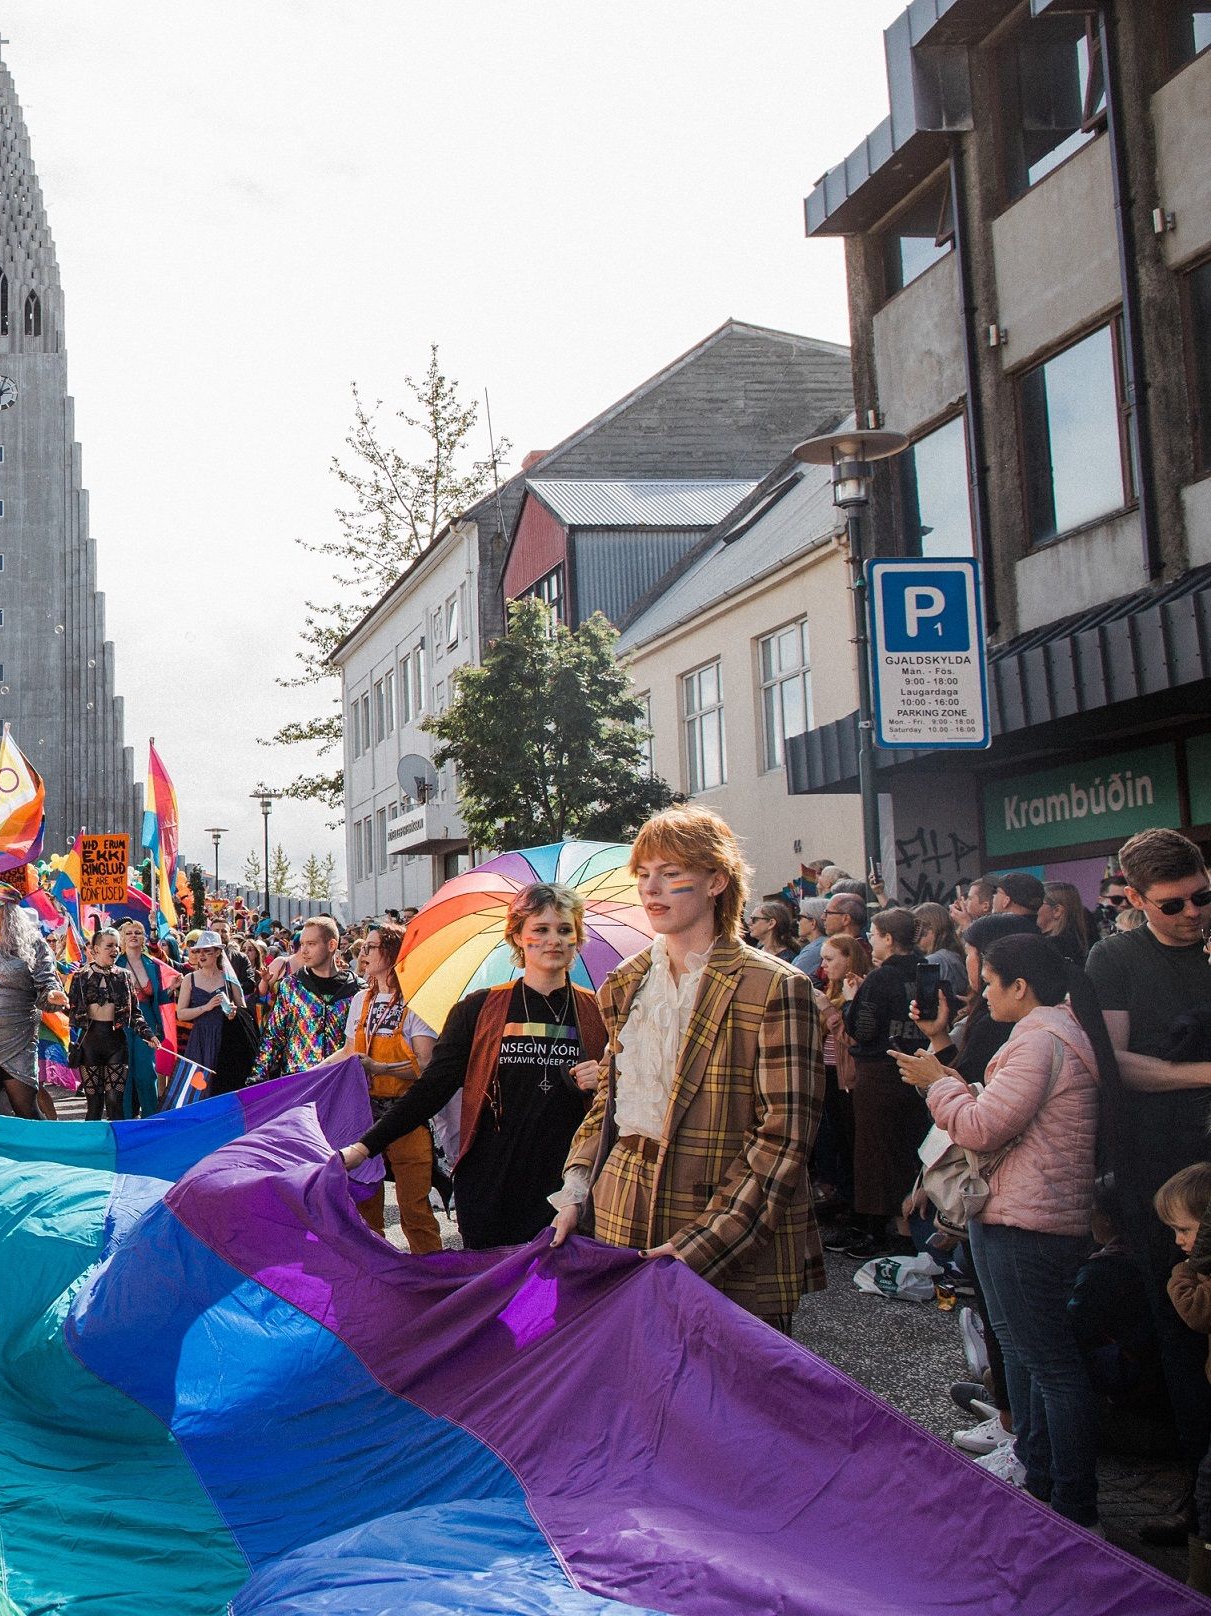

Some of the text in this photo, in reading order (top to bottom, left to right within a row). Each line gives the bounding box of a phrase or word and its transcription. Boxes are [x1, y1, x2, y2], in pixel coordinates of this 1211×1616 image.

[904, 586, 946, 638] P 1
[885, 656, 971, 665] GJALDSKYLDA
[905, 677, 925, 685] 9:00
[934, 677, 958, 685] 18:00
[900, 688, 959, 697] Laugardaga
[901, 698, 926, 706] 10:00
[934, 698, 959, 706] 16:00
[897, 709, 967, 717] PARKING ZONE
[1004, 770, 1154, 831] Krambúðin
[104, 840, 126, 850] ERUM
[82, 850, 125, 863] EKKI
[82, 876, 123, 886] WE ARE NOT
[81, 887, 124, 901] CONFUSED
[501, 1042, 579, 1057] NSEGIN KÓRI
[499, 1056, 535, 1064] EYKJAVIK
